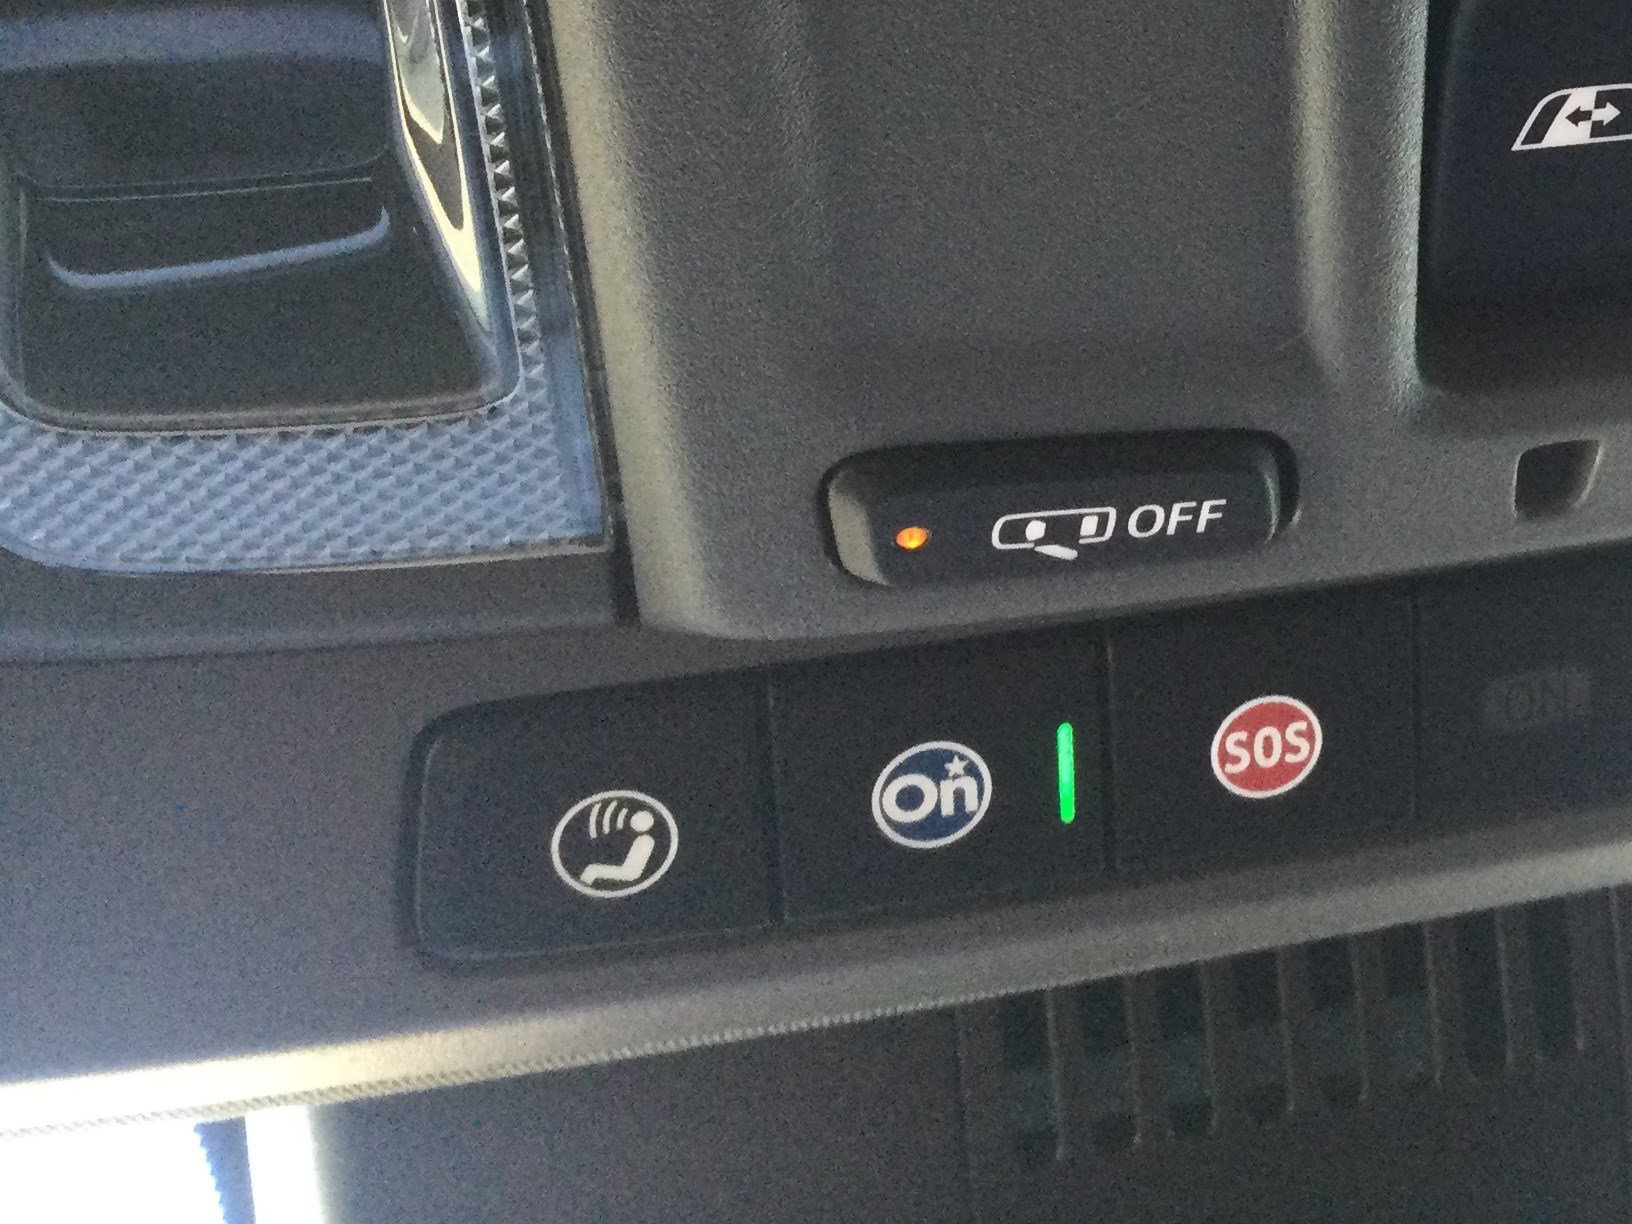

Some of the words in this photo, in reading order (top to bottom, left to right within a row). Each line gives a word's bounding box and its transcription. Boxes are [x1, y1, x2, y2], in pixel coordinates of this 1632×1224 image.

[1126, 498, 1227, 539] OFF
[1223, 720, 1311, 775] SOS
[881, 772, 980, 824] On
